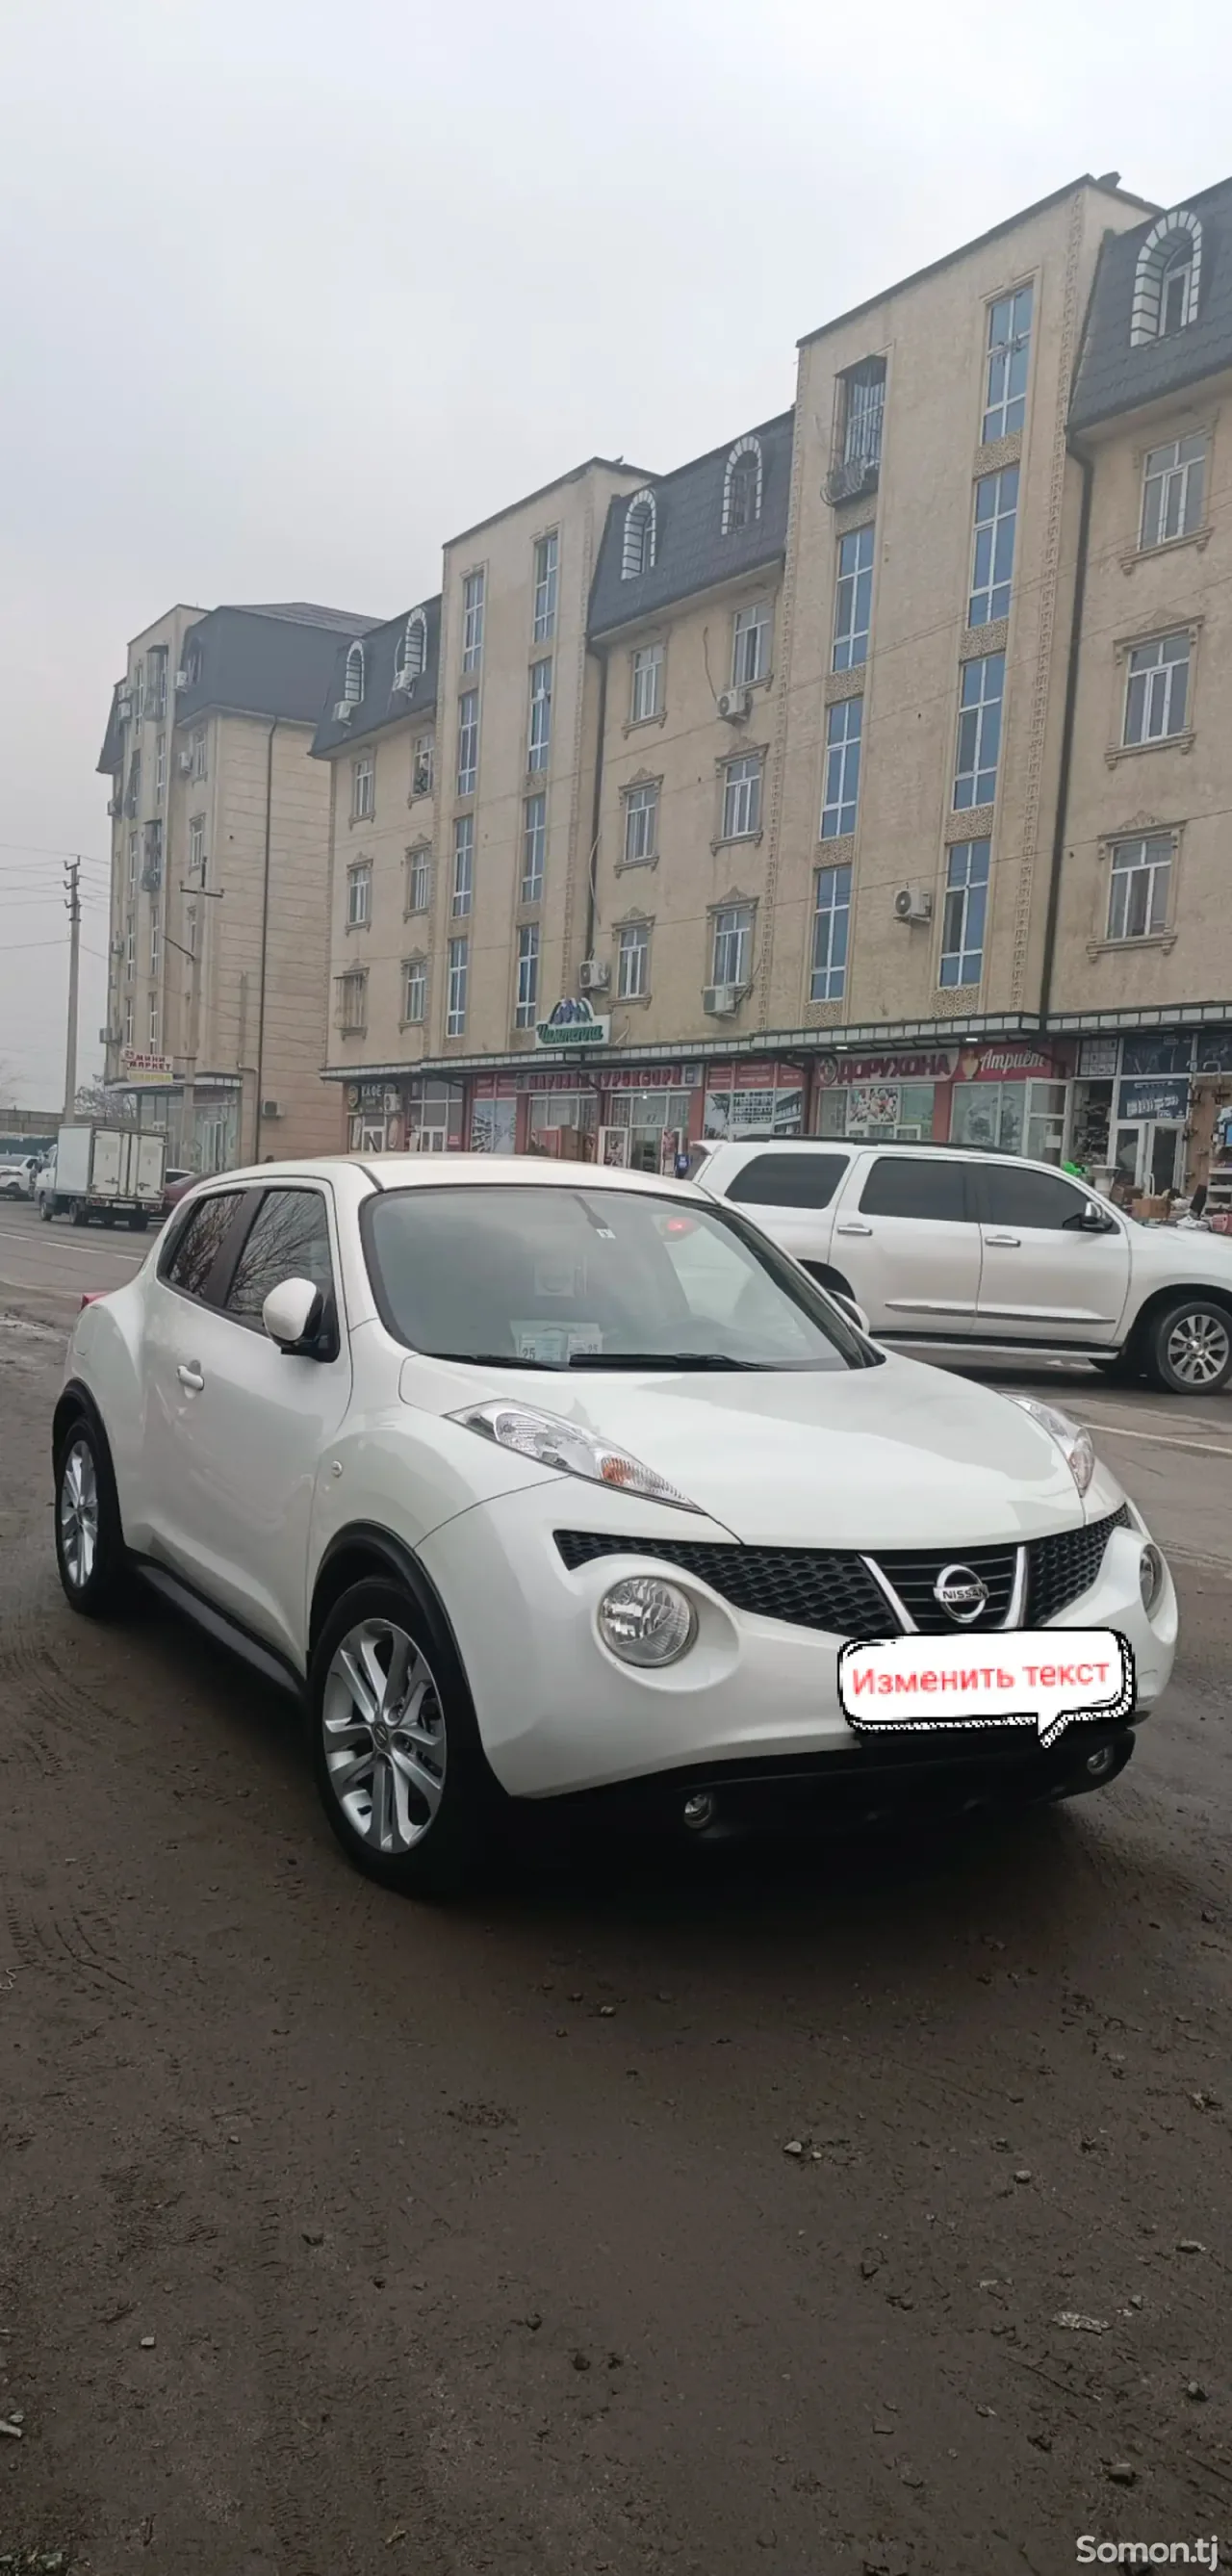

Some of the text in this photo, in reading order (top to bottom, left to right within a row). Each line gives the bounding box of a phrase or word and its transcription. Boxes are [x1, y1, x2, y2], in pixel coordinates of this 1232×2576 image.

[136, 1054, 166, 1064] МИНИ
[129, 1061, 171, 1071] МАРКЕТ
[837, 1054, 951, 1084] ДОРУХОНА
[942, 1586, 987, 1599] NISSAN
